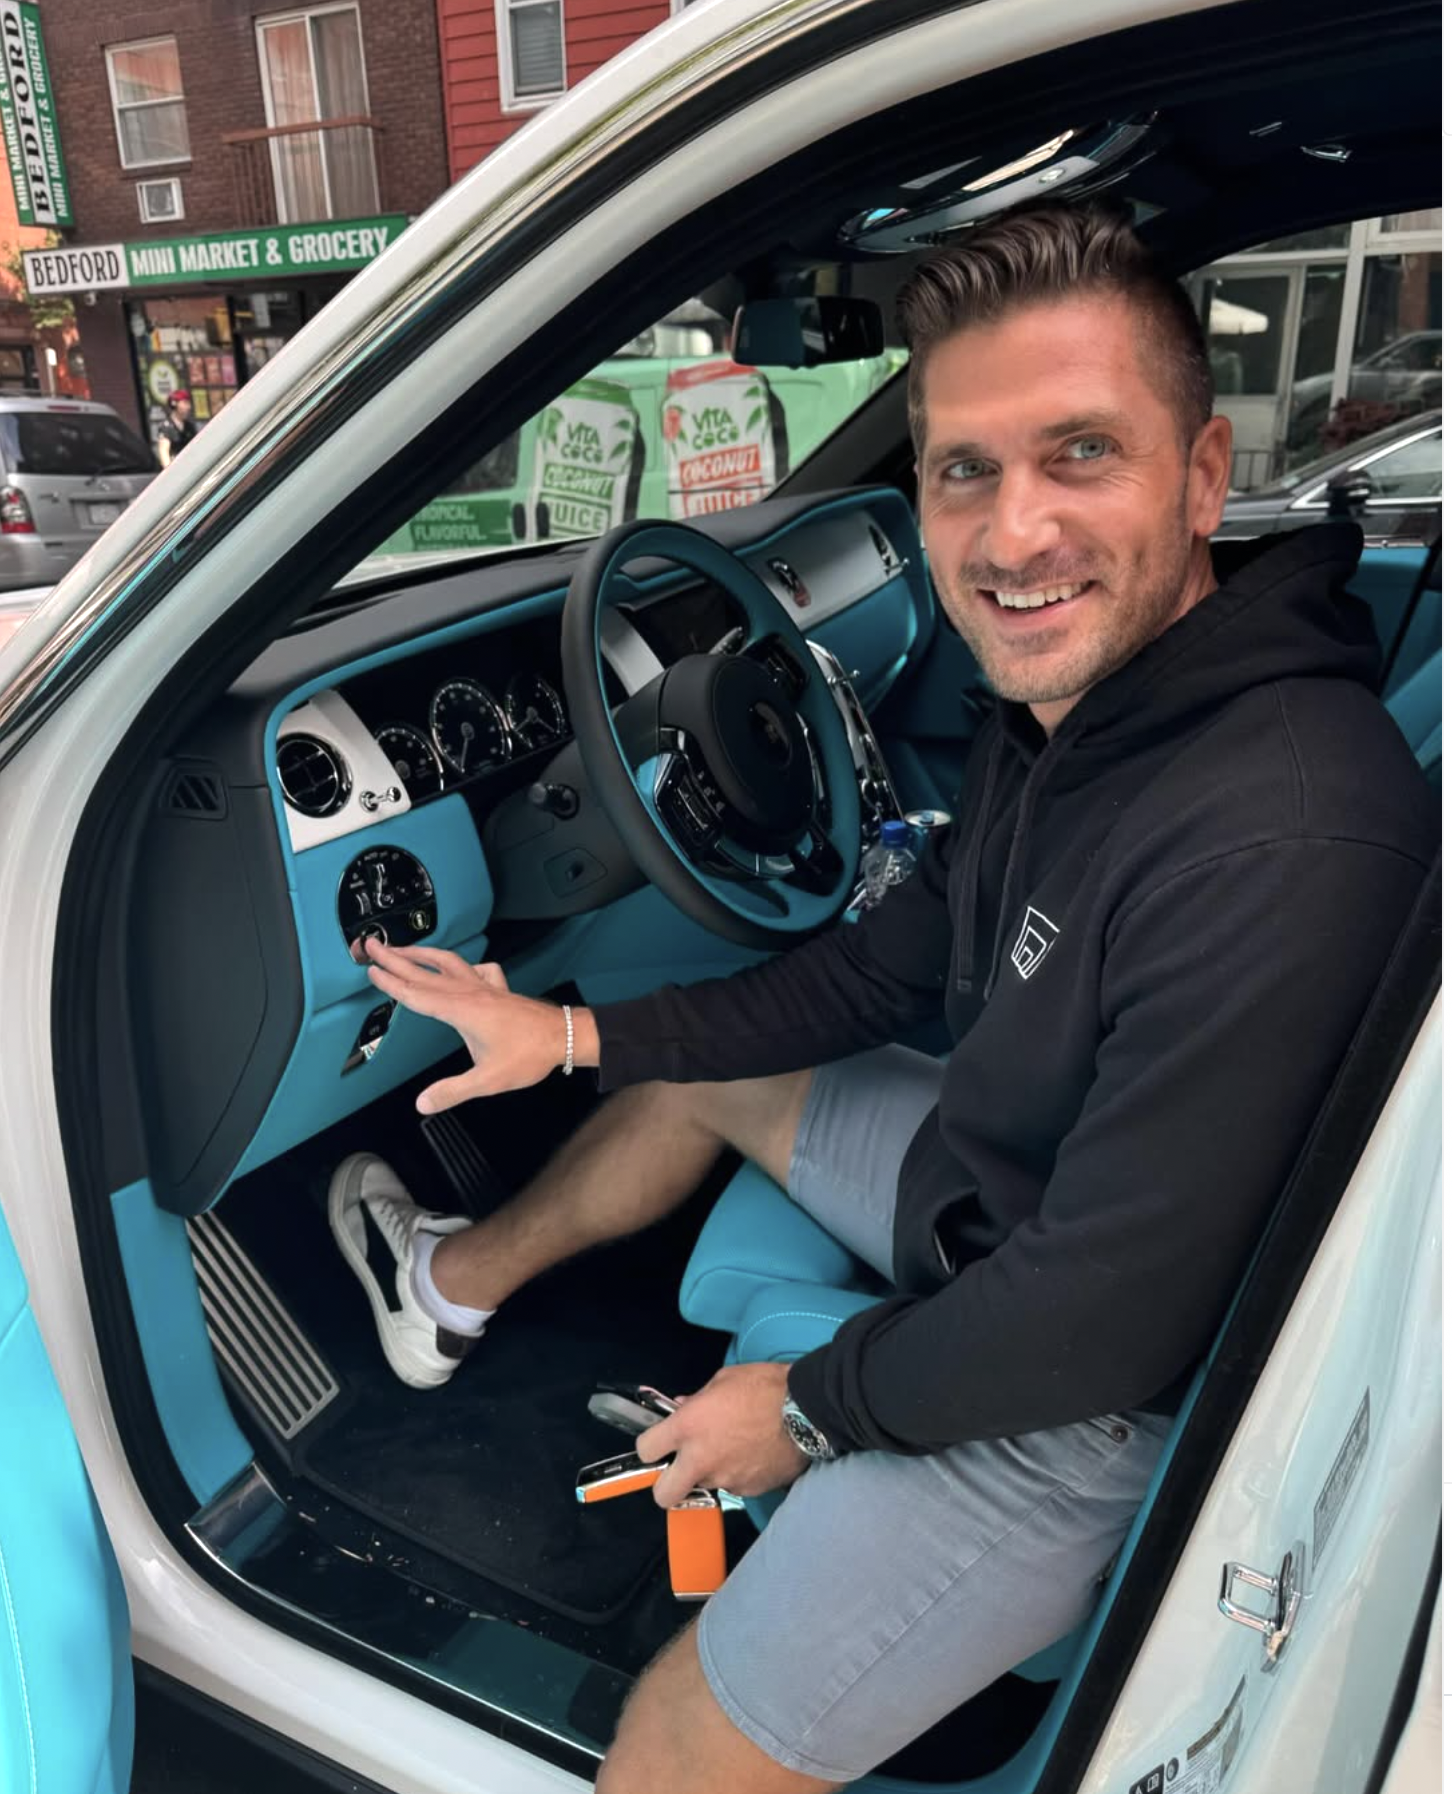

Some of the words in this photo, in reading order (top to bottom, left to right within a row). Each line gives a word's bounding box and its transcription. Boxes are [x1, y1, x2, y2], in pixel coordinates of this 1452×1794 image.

[23, 16, 46, 94] GROCERY
[4, 11, 50, 212] BEDFORD
[40, 114, 61, 179] MARKET
[14, 174, 31, 211] MINI
[52, 181, 68, 218] MINI
[31, 250, 120, 288] BEDFORD
[131, 247, 176, 277] MINI
[179, 239, 259, 274] MARKET
[266, 237, 283, 265] &
[288, 227, 388, 264] GROCERY
[567, 421, 600, 445] VITA
[692, 406, 733, 431] VITA
[682, 447, 757, 485] COCONUT
[549, 502, 605, 530] UICE
